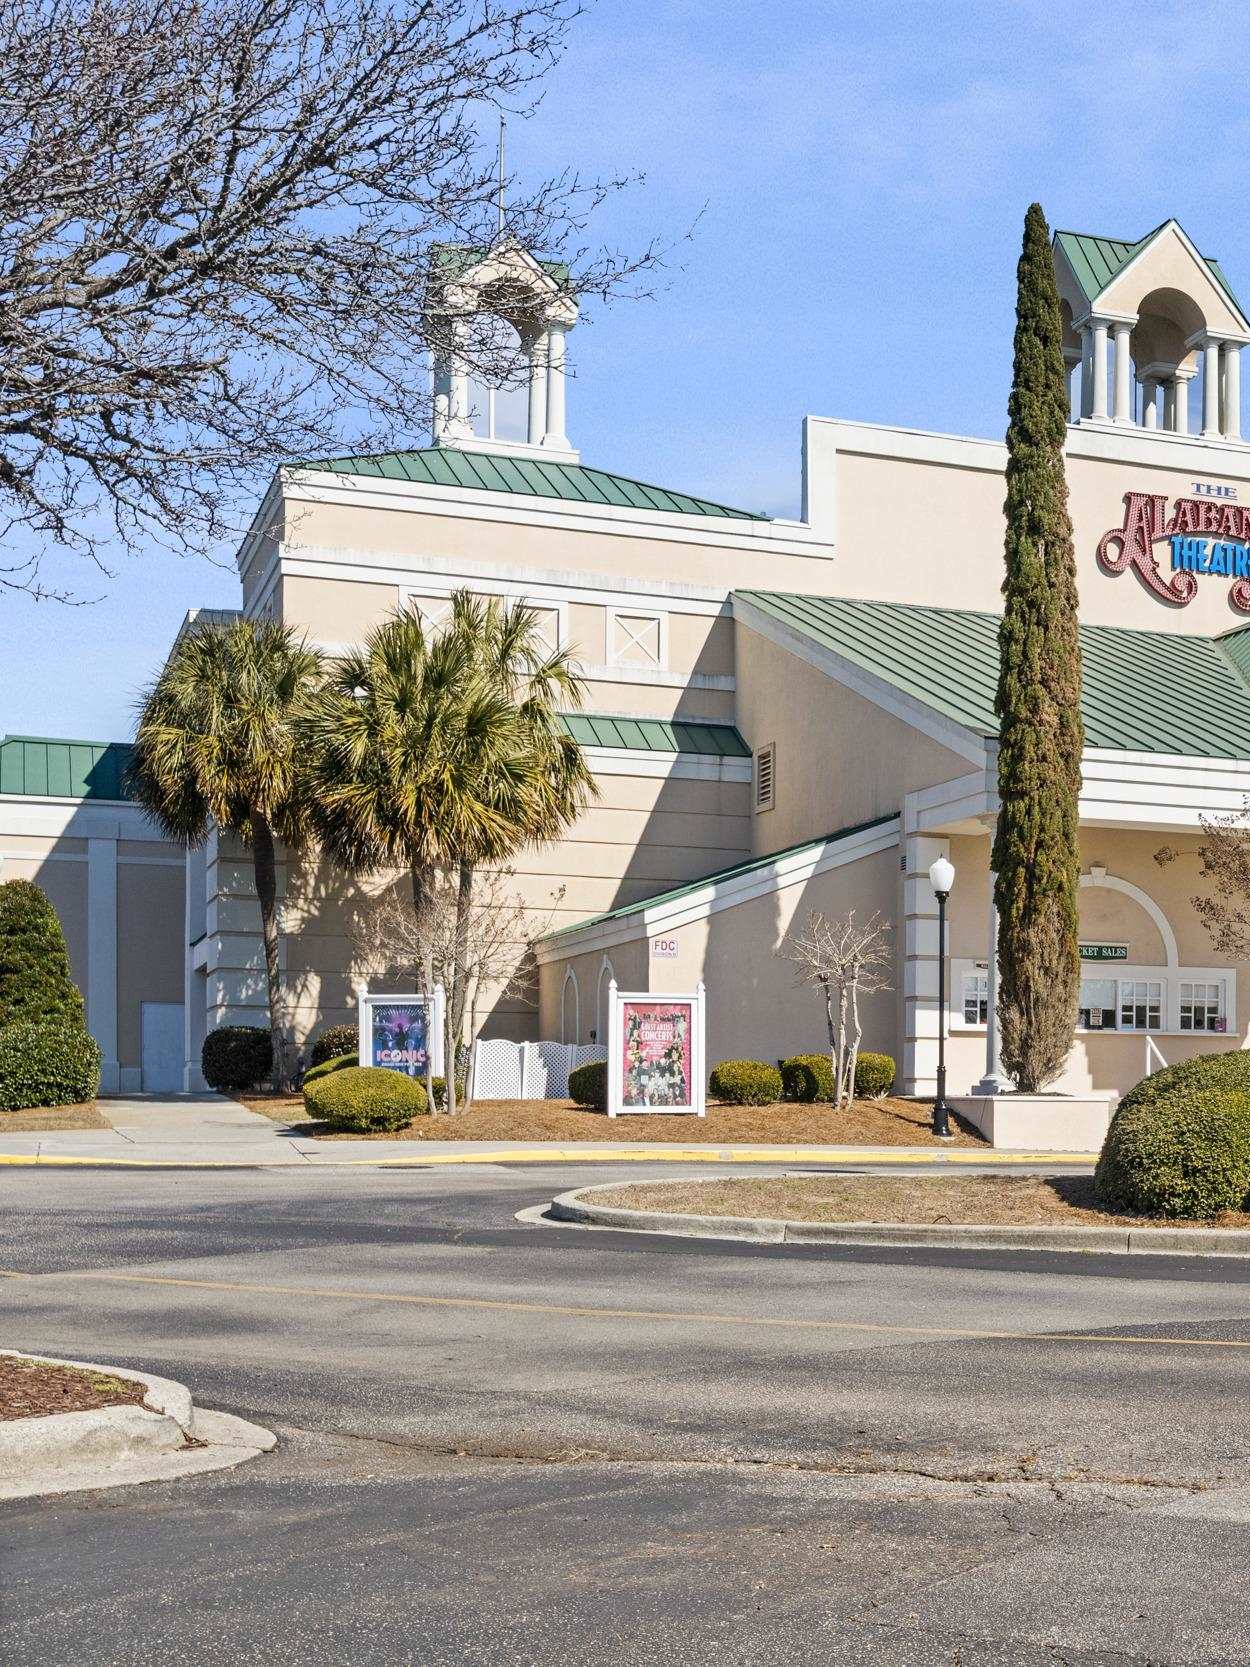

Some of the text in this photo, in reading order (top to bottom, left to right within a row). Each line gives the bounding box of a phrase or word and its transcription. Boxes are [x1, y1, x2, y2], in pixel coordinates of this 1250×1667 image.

[1191, 482, 1237, 498] THE
[654, 940, 676, 951] FDC
[1078, 946, 1126, 957] CKET SALES
[641, 1030, 673, 1041] CONCERTS
[376, 1050, 426, 1062] ICONIC
